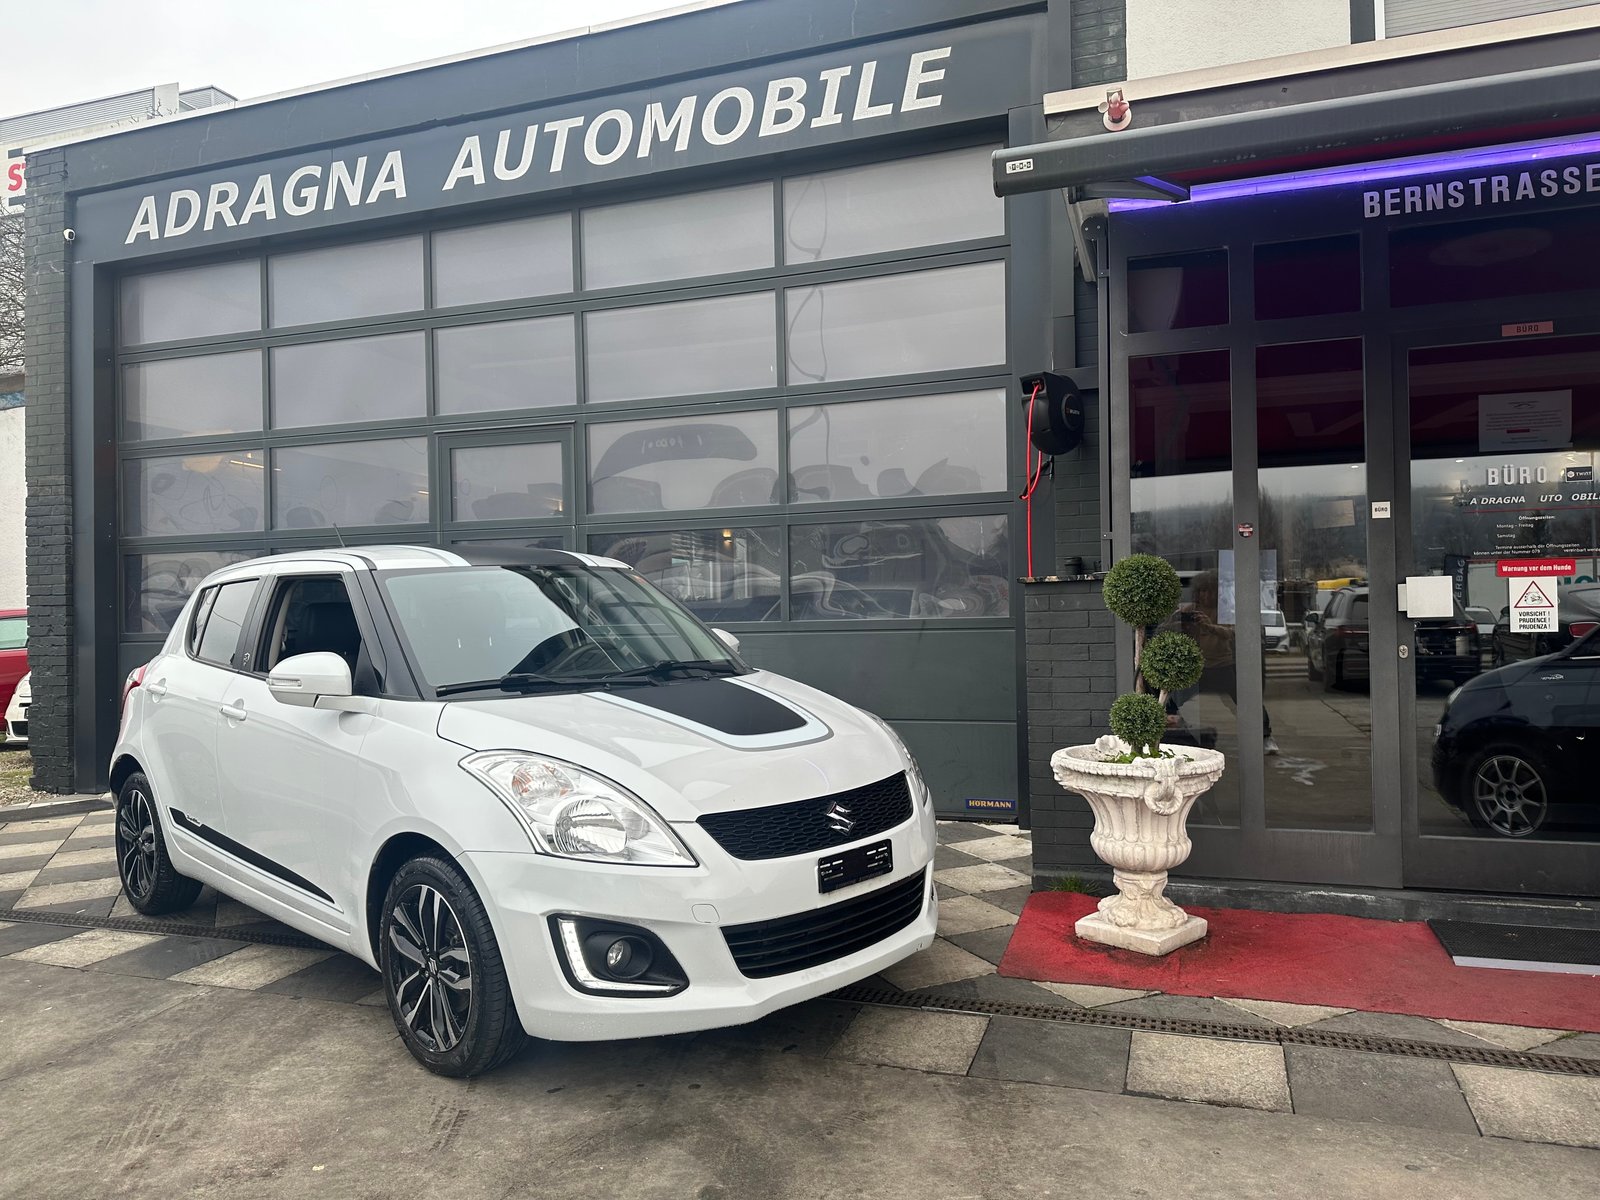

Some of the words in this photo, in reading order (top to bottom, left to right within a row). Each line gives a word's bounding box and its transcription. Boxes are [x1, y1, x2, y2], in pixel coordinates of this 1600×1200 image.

[124, 149, 407, 245] ADRAGNA
[441, 46, 952, 192] AUTOMOBILE
[1363, 163, 1600, 219] BERNSTRASSE
[1487, 464, 1548, 486] BÜRO
[1571, 492, 1600, 501] OBIL
